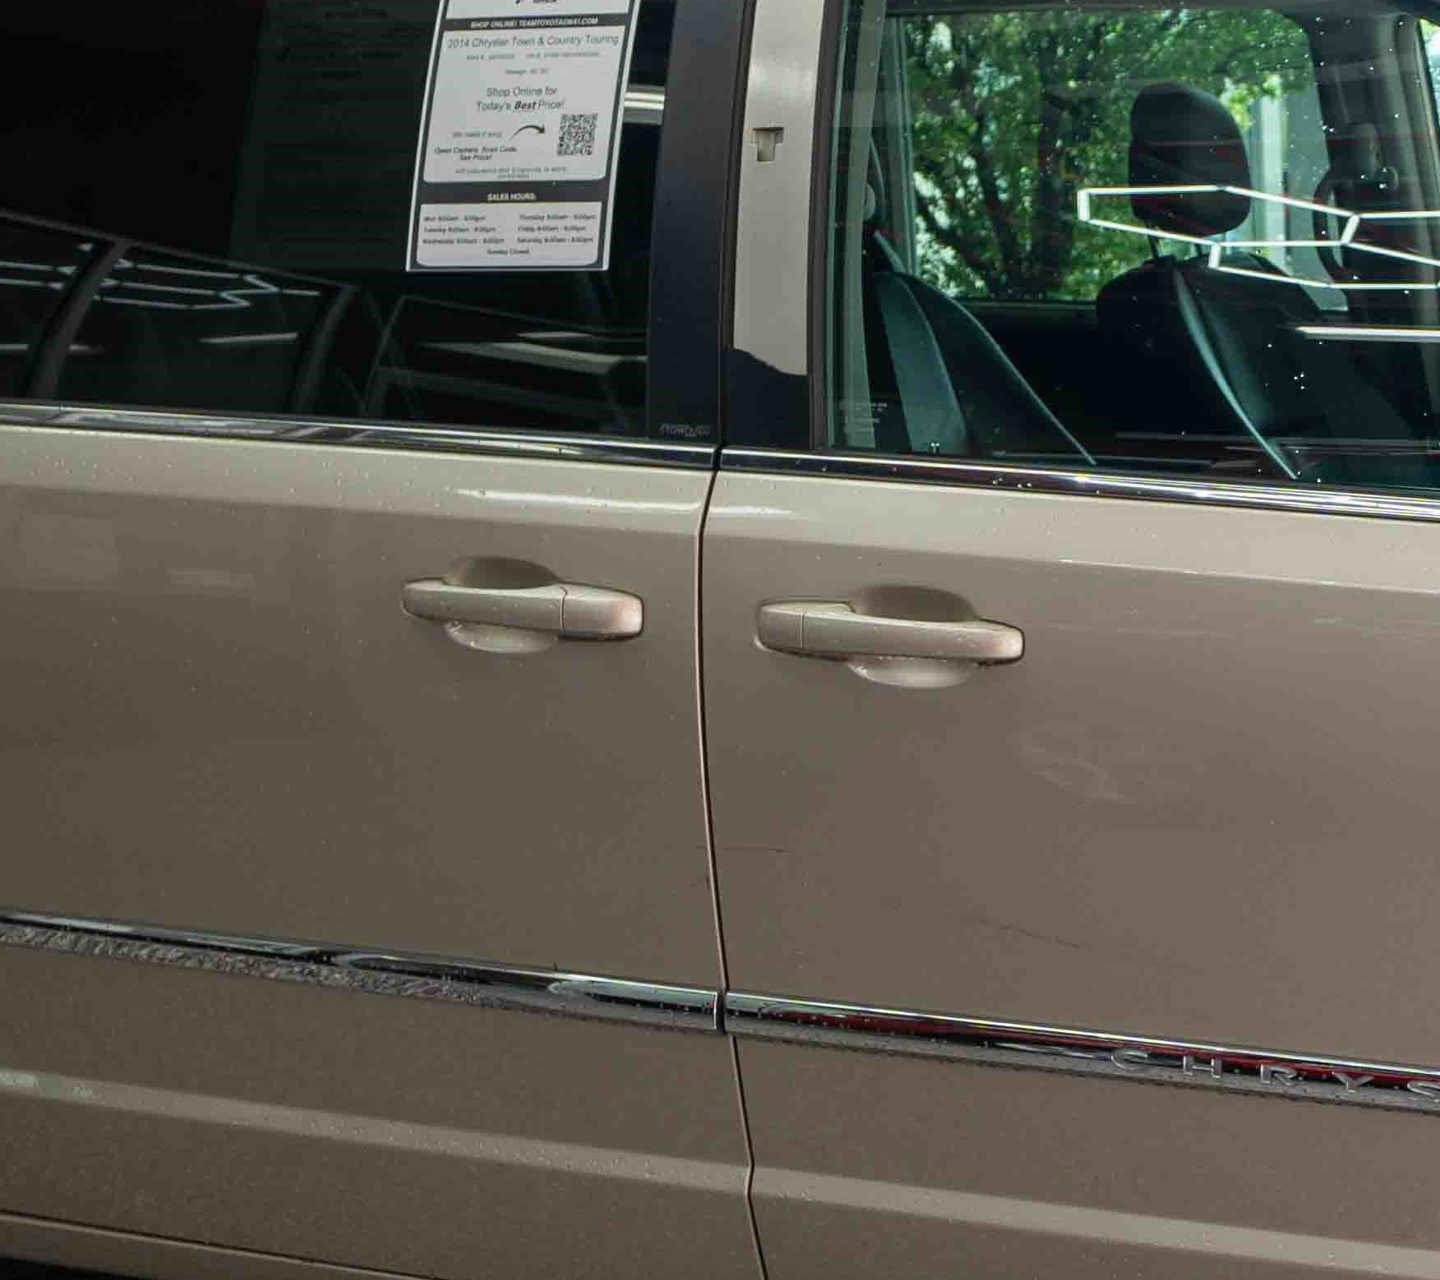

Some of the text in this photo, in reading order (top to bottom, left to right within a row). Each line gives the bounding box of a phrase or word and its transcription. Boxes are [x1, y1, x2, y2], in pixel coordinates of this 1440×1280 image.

[447, 34, 619, 50] 2014 Chrysler Town & Country Touring
[486, 85, 558, 99] Shop Online for
[476, 99, 565, 112] Today's Best Price!
[488, 192, 510, 201] SALES
